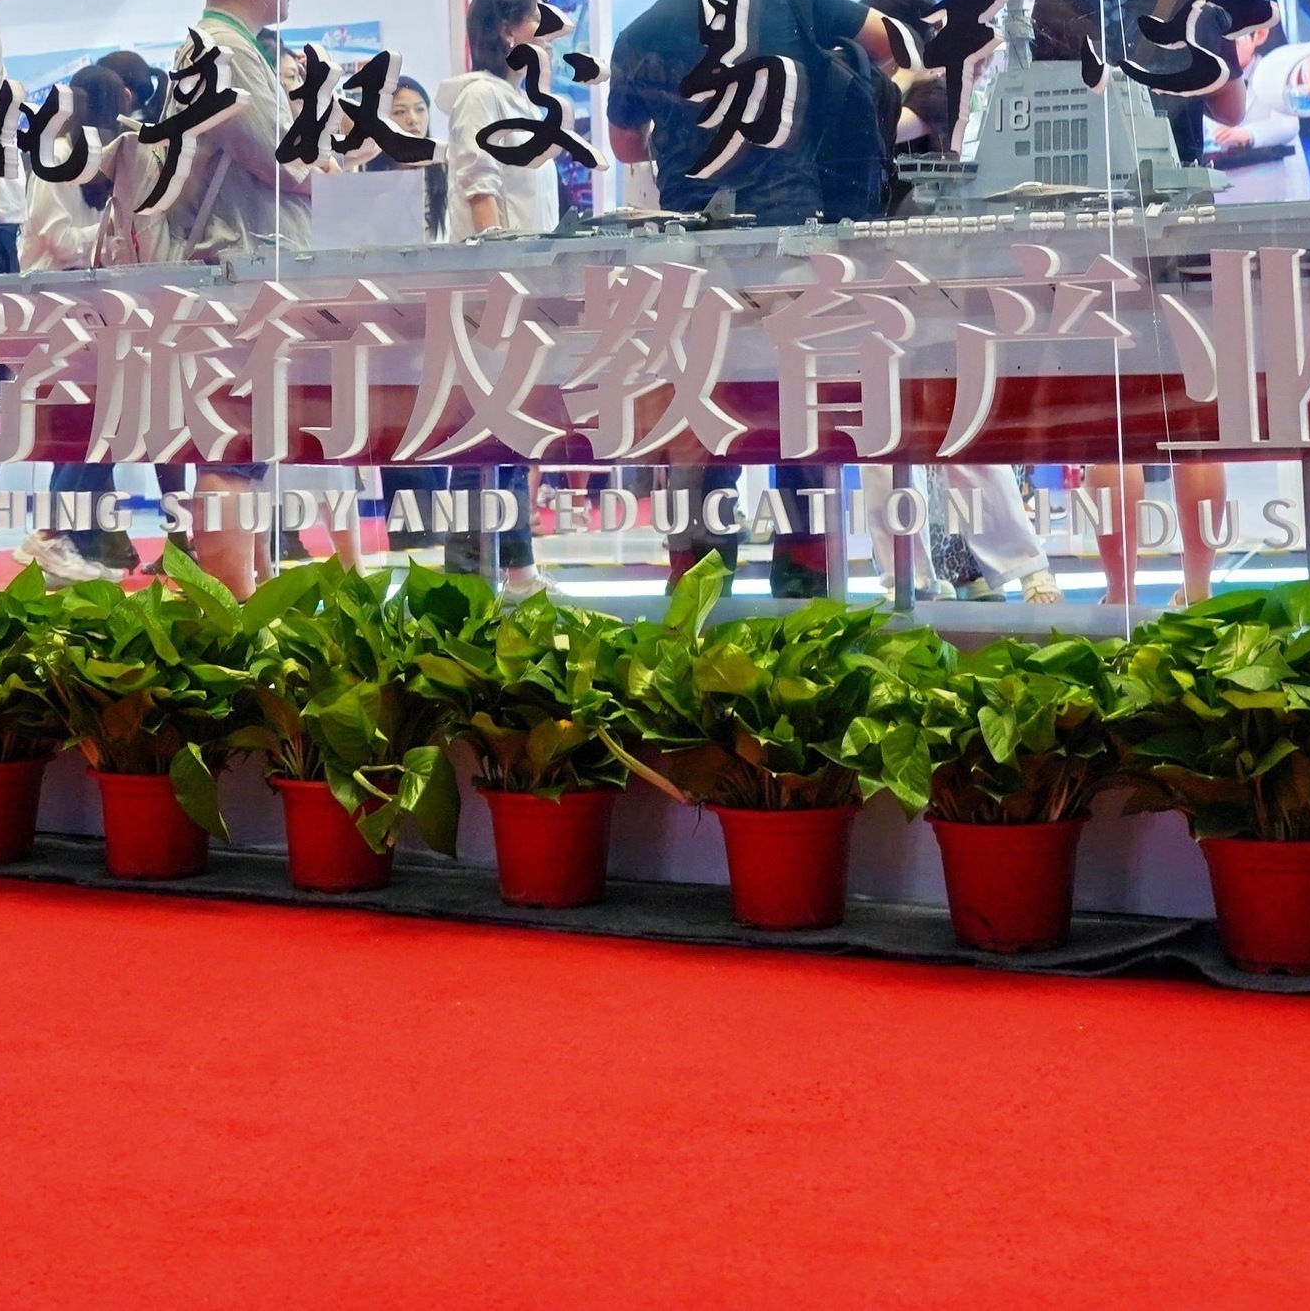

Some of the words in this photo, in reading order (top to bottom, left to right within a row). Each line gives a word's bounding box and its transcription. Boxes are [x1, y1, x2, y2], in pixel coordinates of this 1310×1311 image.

[995, 96, 1031, 133] 18
[159, 488, 359, 533] STUDY
[386, 488, 520, 535] AND
[551, 487, 986, 536] EDUCATION
